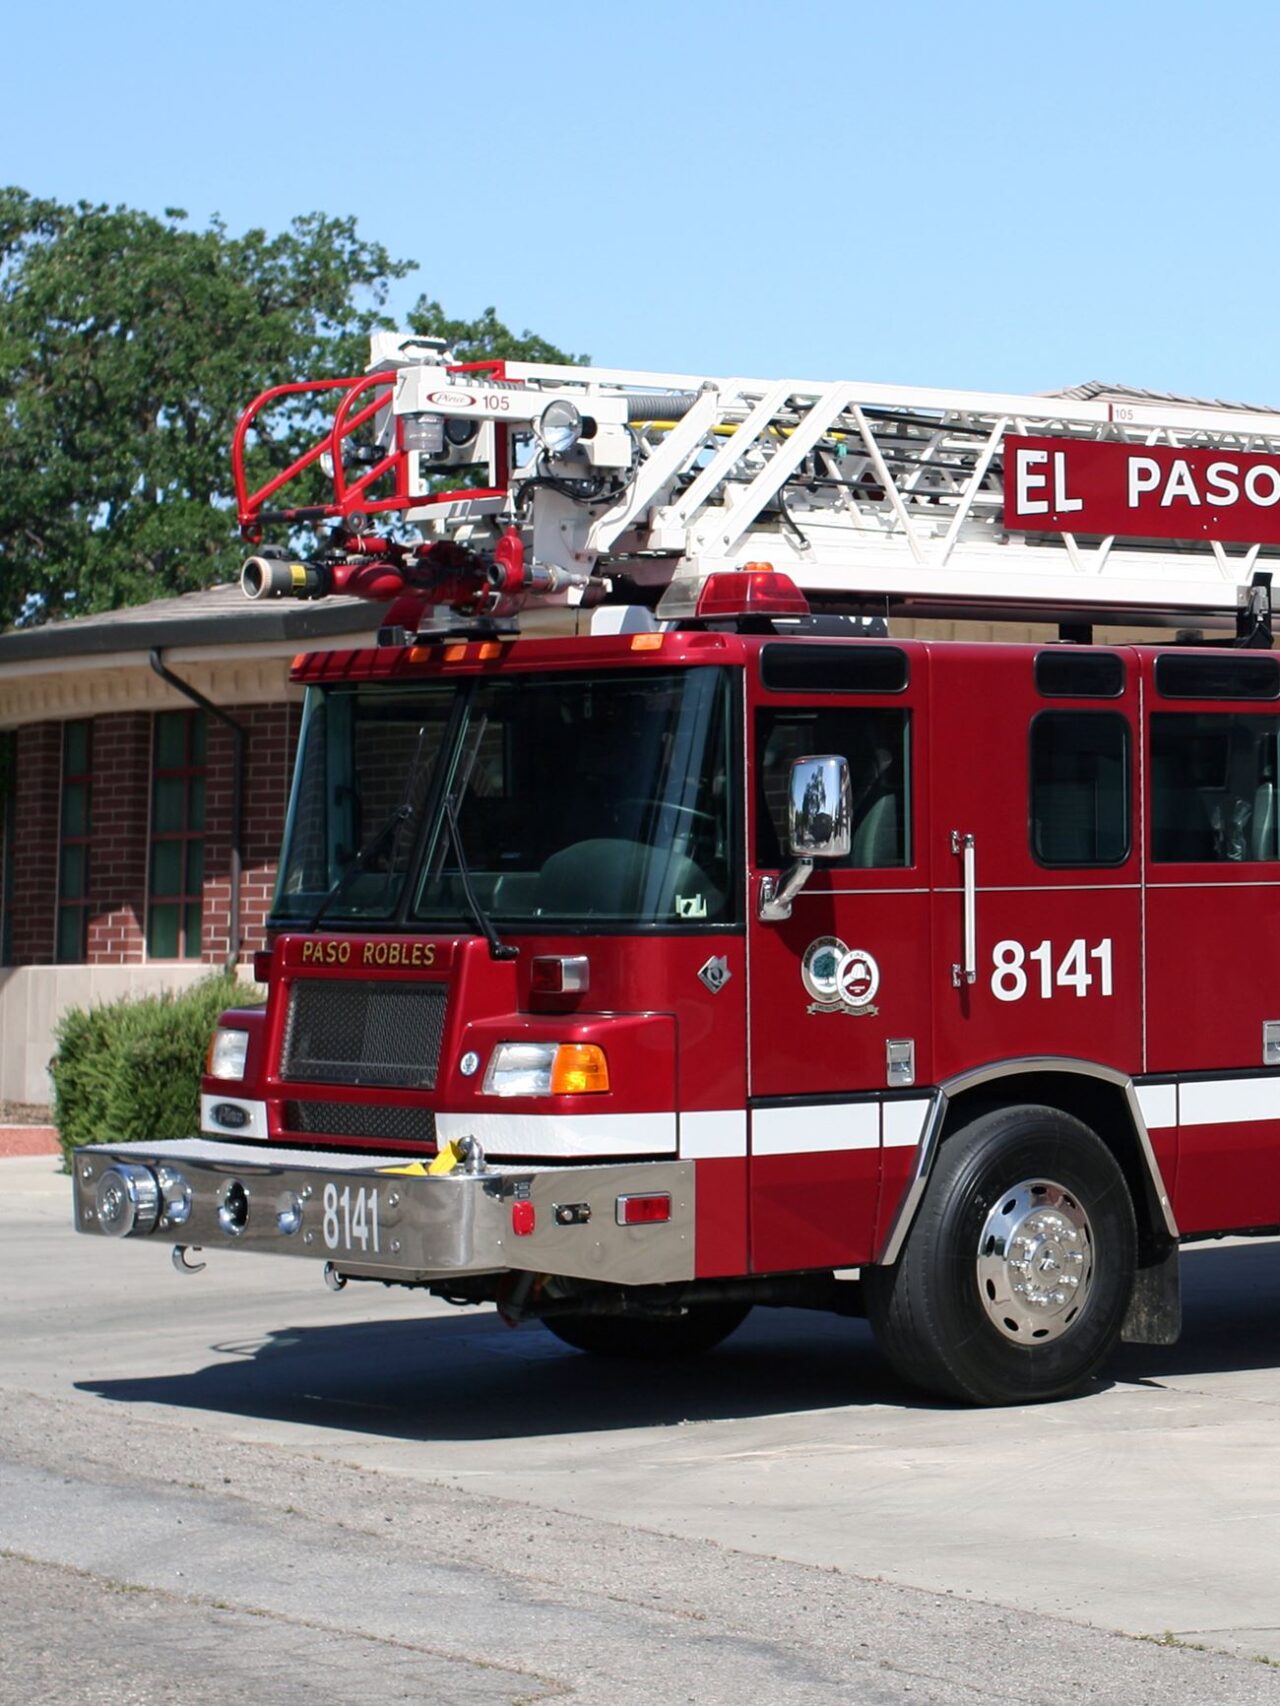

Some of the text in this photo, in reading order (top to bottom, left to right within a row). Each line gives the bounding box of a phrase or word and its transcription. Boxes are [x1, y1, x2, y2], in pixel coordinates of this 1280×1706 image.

[483, 395, 510, 410] 105
[1115, 408, 1134, 420] 105
[1016, 448, 1083, 515] EL
[302, 941, 436, 965] PASO ROBLES
[991, 938, 1113, 1001] 8141
[323, 1183, 379, 1252] 8141
